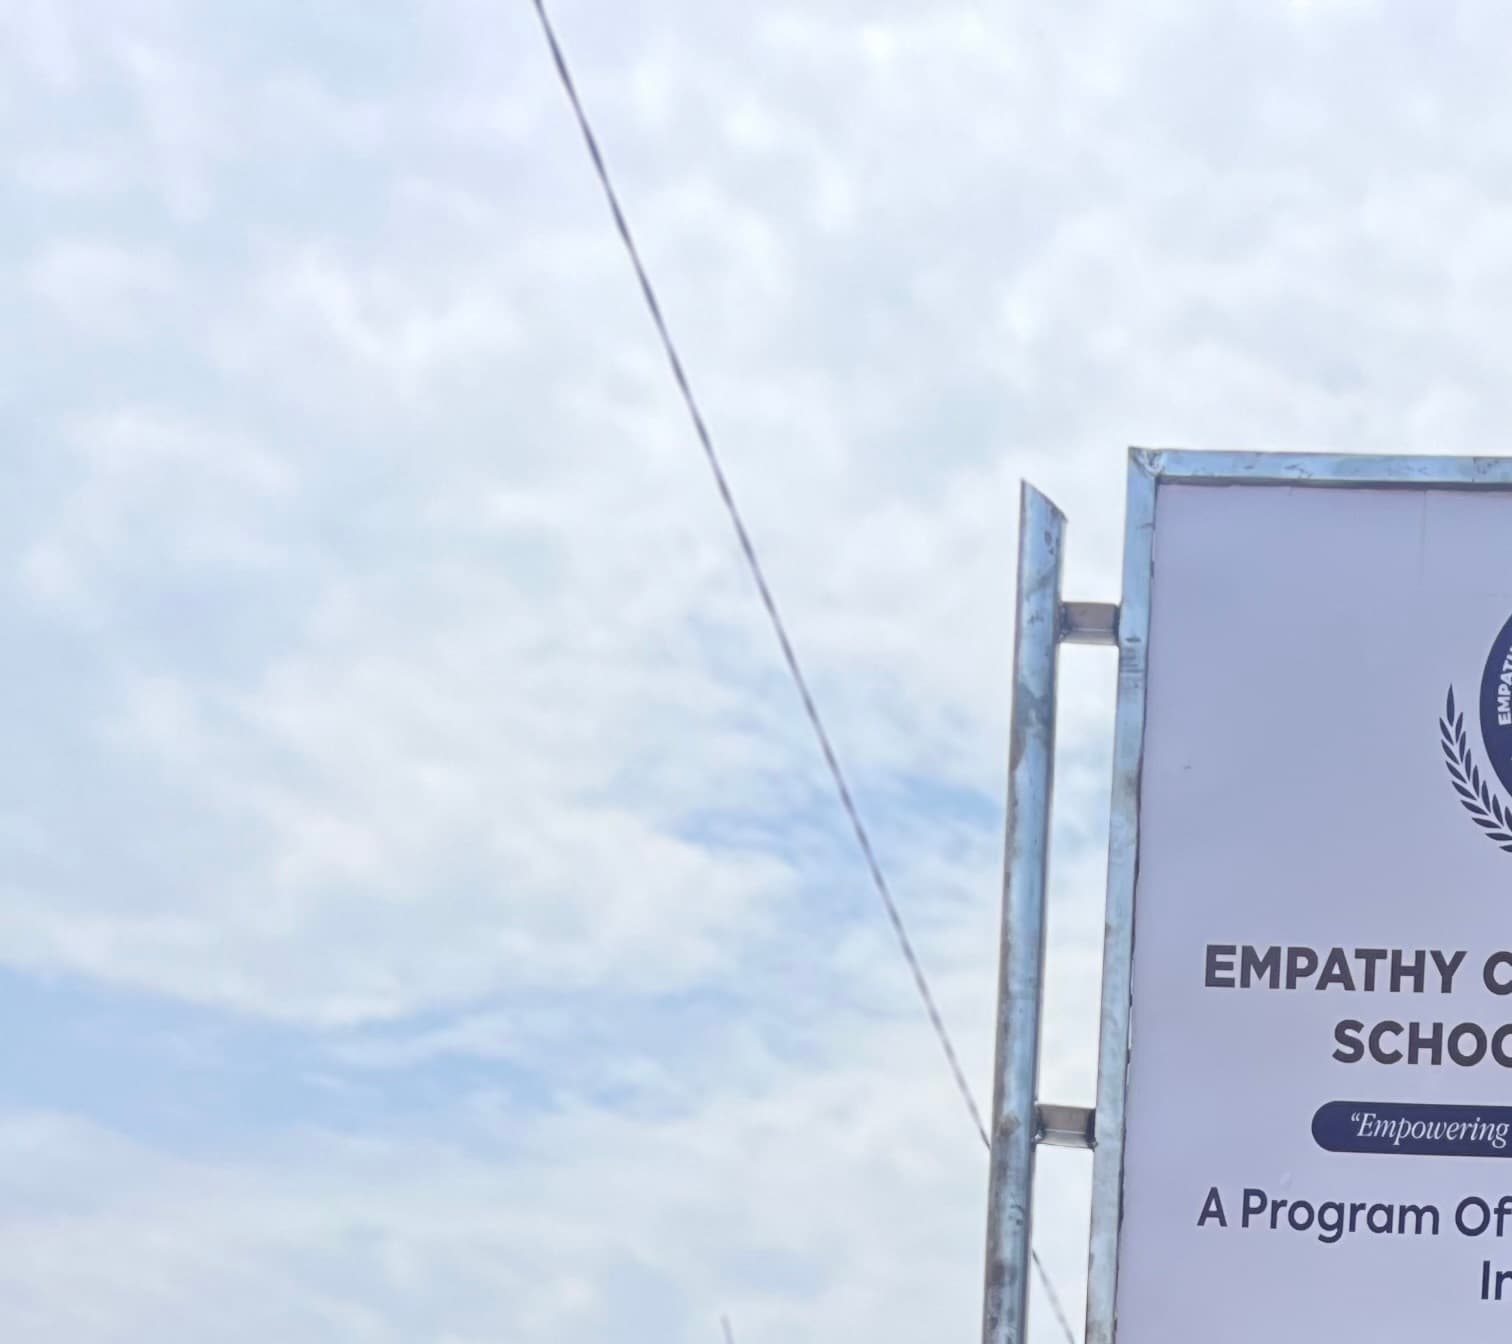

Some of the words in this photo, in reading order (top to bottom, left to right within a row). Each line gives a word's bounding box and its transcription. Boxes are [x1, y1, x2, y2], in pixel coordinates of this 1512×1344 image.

[1205, 944, 1467, 993] EMPATHY
[1197, 1187, 1227, 1227] A
[1242, 1189, 1439, 1243] Program
